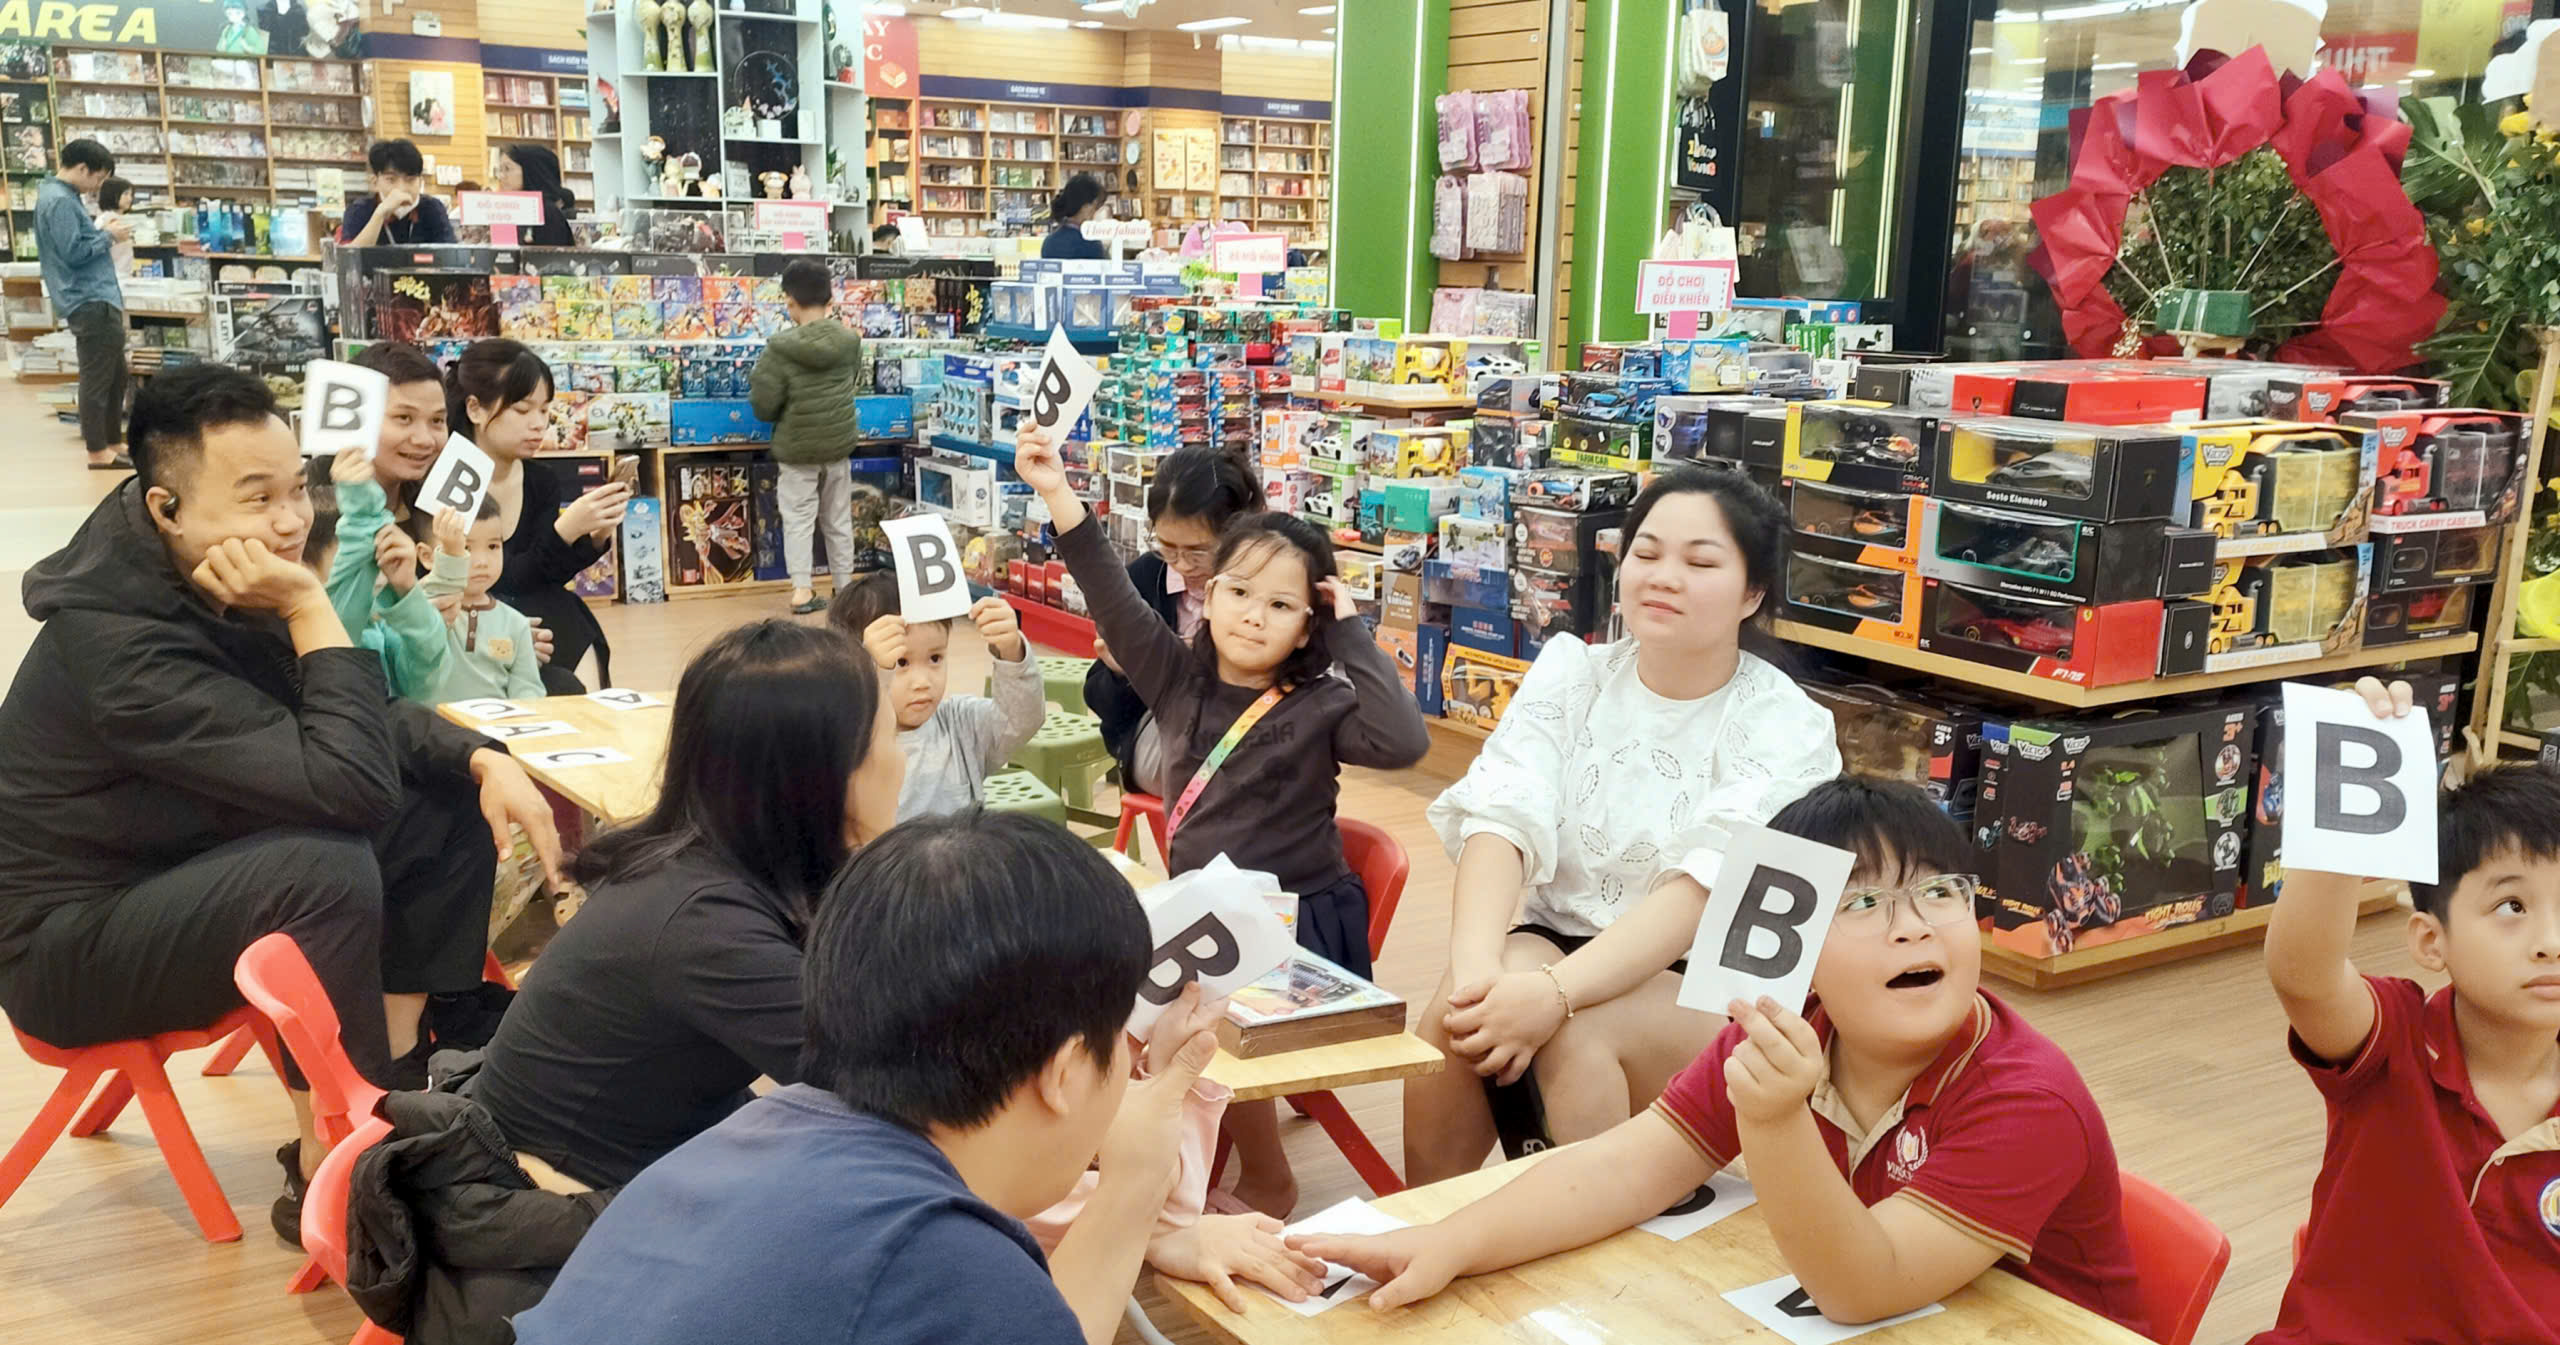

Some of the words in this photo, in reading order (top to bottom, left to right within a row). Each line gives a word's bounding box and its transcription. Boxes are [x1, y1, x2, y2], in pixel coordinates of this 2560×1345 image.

[0, 0, 156, 43] AREA
[1658, 270, 1673, 288] ĐỒ
[1677, 273, 1704, 288] CHƠI
[320, 382, 362, 430] B
[1033, 357, 1071, 428] B
[1576, 451, 1594, 463] FARM
[1595, 454, 1608, 466] CAR
[436, 458, 480, 513] B
[2009, 494, 2047, 507] Elemento
[2392, 520, 2416, 531] TRUCK
[2419, 518, 2446, 529] CARRY
[2447, 516, 2466, 527] CASE
[907, 533, 957, 596] B
[495, 726, 550, 737] A
[1934, 732, 1952, 745] 3+
[547, 752, 606, 763] C
[2314, 721, 2407, 835] B
[1719, 864, 1818, 979] B
[1136, 911, 1240, 1006] B
